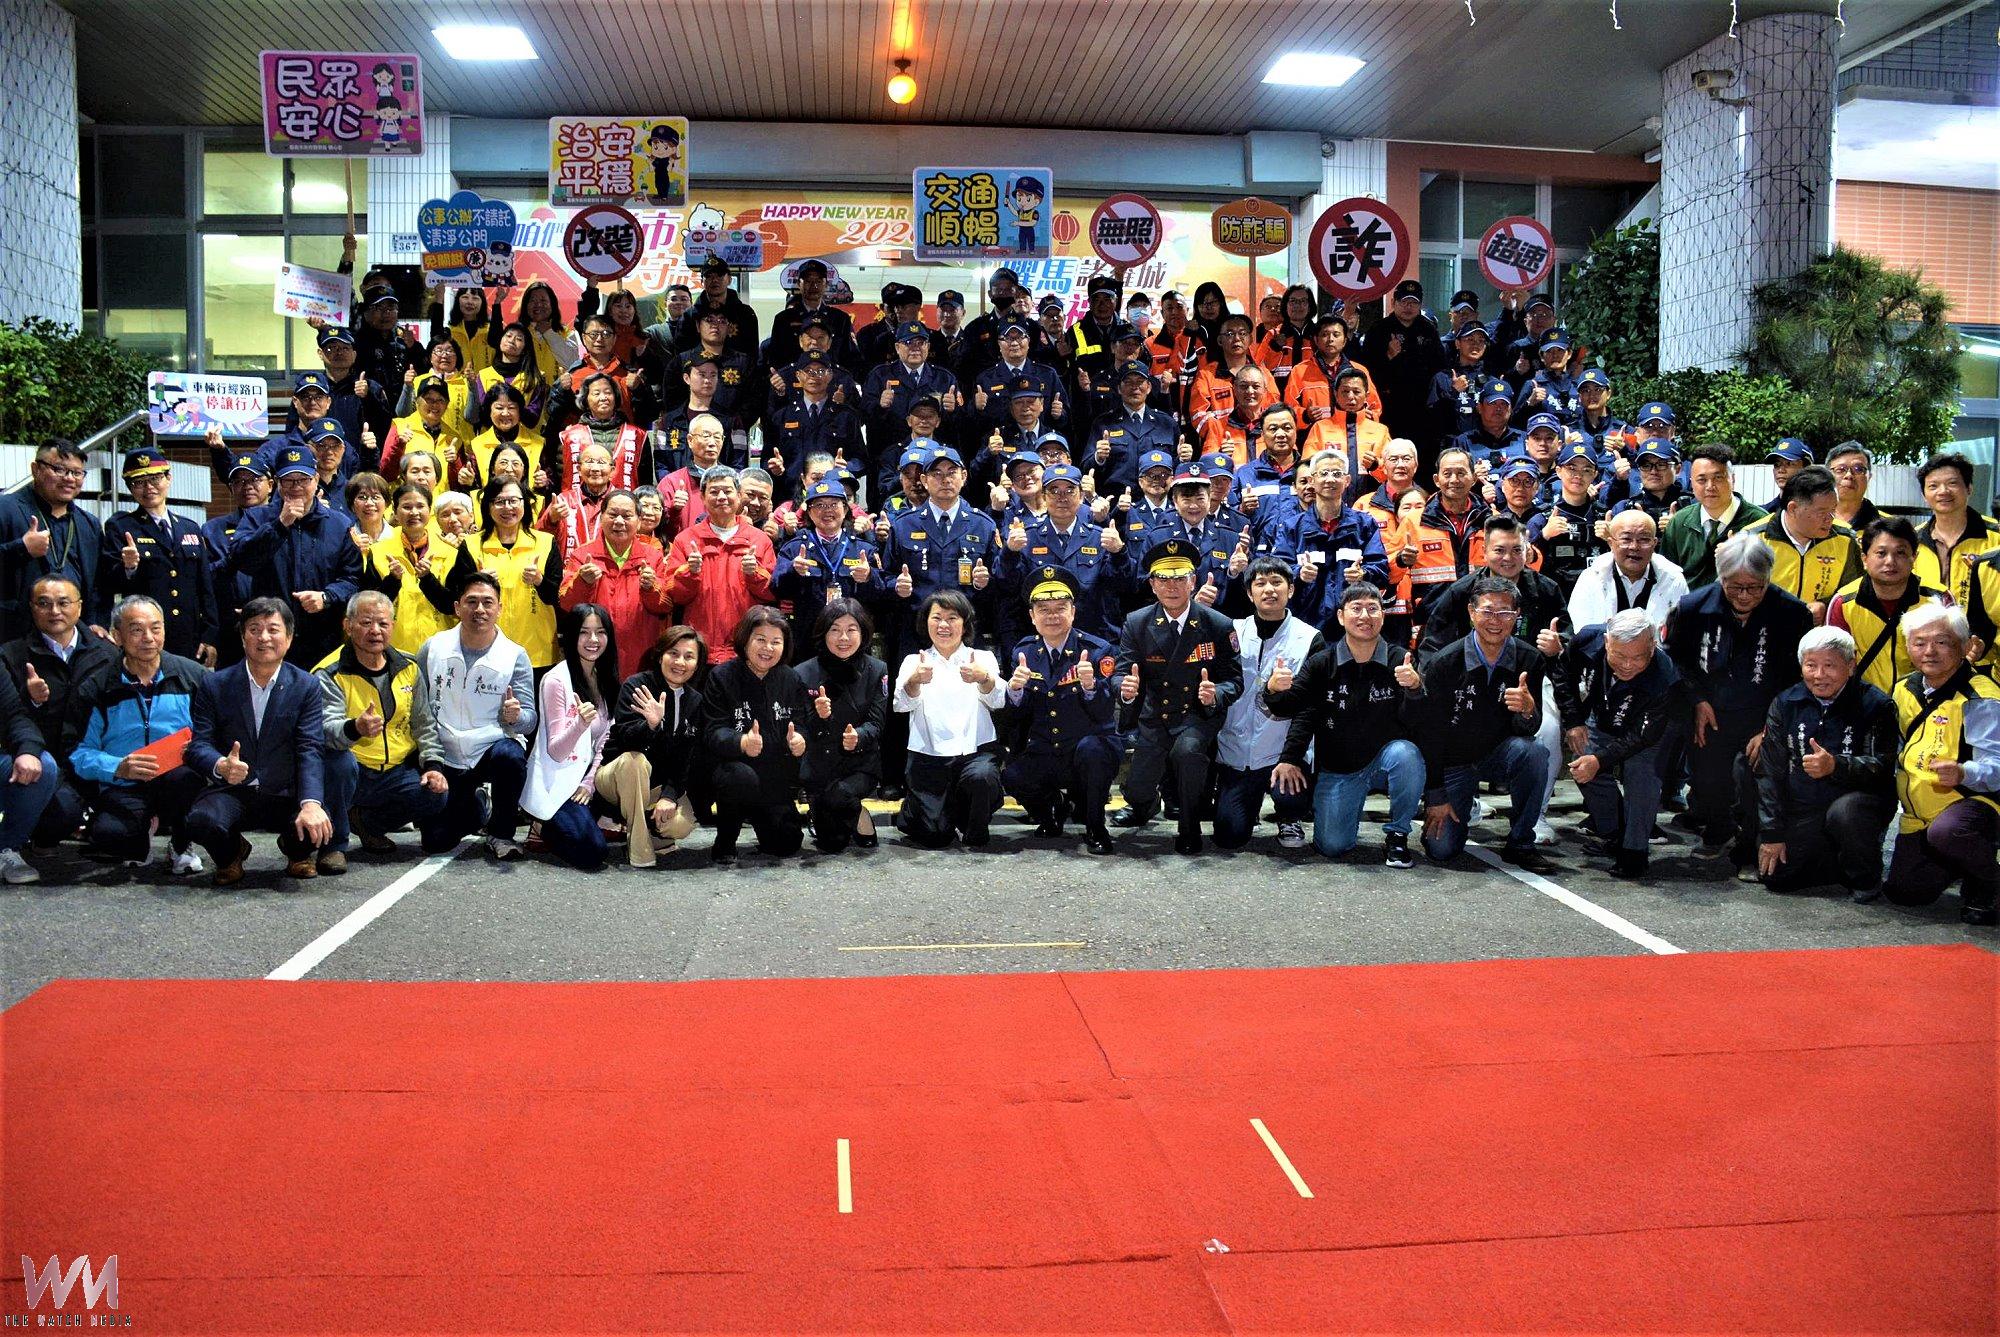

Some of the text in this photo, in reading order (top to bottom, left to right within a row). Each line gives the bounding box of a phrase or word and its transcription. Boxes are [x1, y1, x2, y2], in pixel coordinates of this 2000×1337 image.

[276, 57, 361, 99] 民眾
[277, 101, 364, 141] 安心
[559, 122, 634, 158] 治安
[559, 160, 634, 195] 平穩
[925, 173, 998, 209] 交通
[420, 207, 512, 227] 公事公辦不請託
[764, 205, 908, 219] HAPPY NEW YEAR
[426, 228, 488, 248] 清淨公門
[573, 224, 634, 258] 改裝
[842, 221, 914, 243] 202
[925, 211, 999, 246] 順暢
[1097, 217, 1153, 245] 無照
[1219, 216, 1286, 245] 防詐騙
[399, 242, 418, 251] 367
[1329, 213, 1391, 283] 詐
[1484, 233, 1549, 275] 超速
[193, 381, 262, 396] 車輛行經路口
[206, 396, 262, 411] 停讓行人
